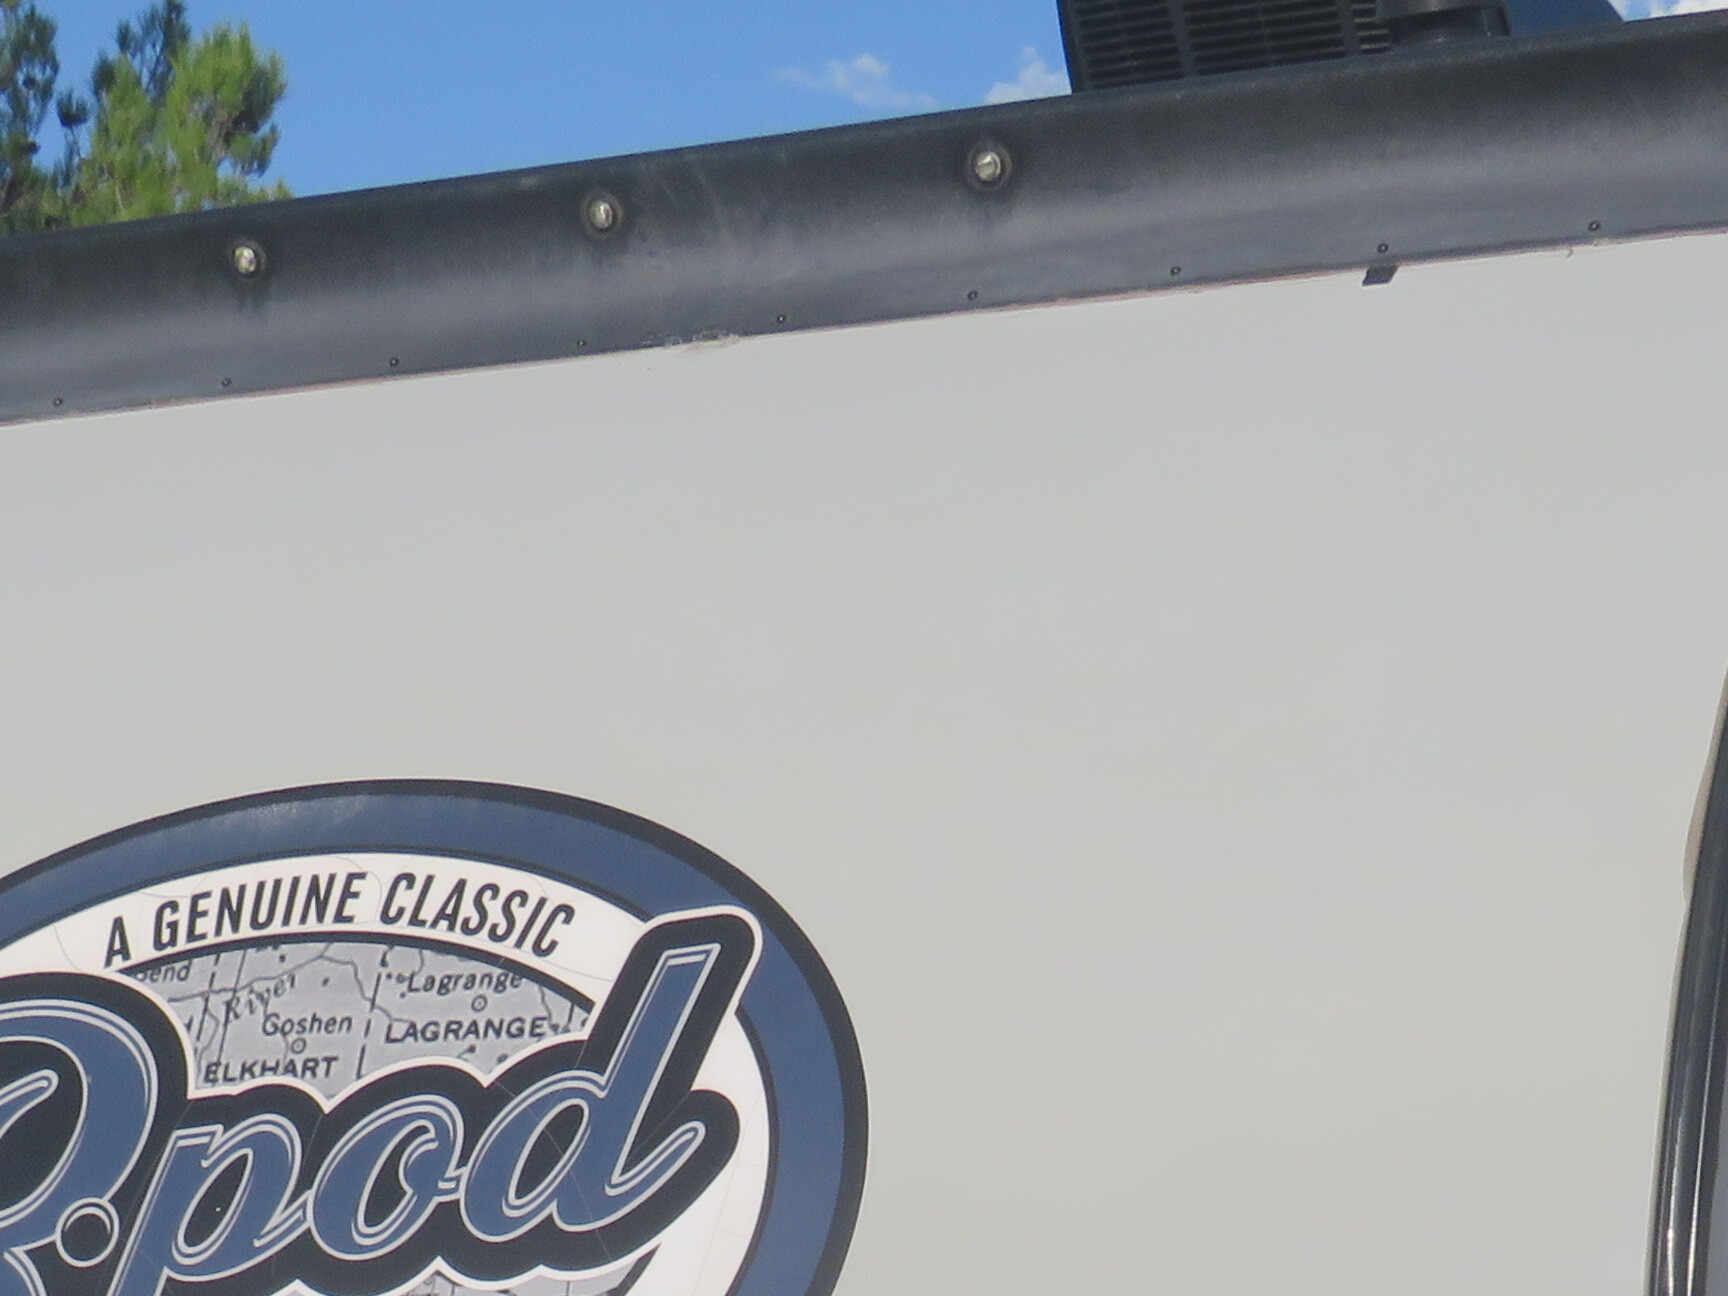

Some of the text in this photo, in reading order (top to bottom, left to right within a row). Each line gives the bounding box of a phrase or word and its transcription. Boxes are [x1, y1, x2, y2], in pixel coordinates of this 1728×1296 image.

[104, 872, 575, 967] A GENUINE CLASSIC
[407, 970, 523, 993] Lagrange
[262, 1012, 353, 1037] Goshen
[385, 1016, 548, 1043] LAGRANGE
[204, 1056, 339, 1085] ELKHART
